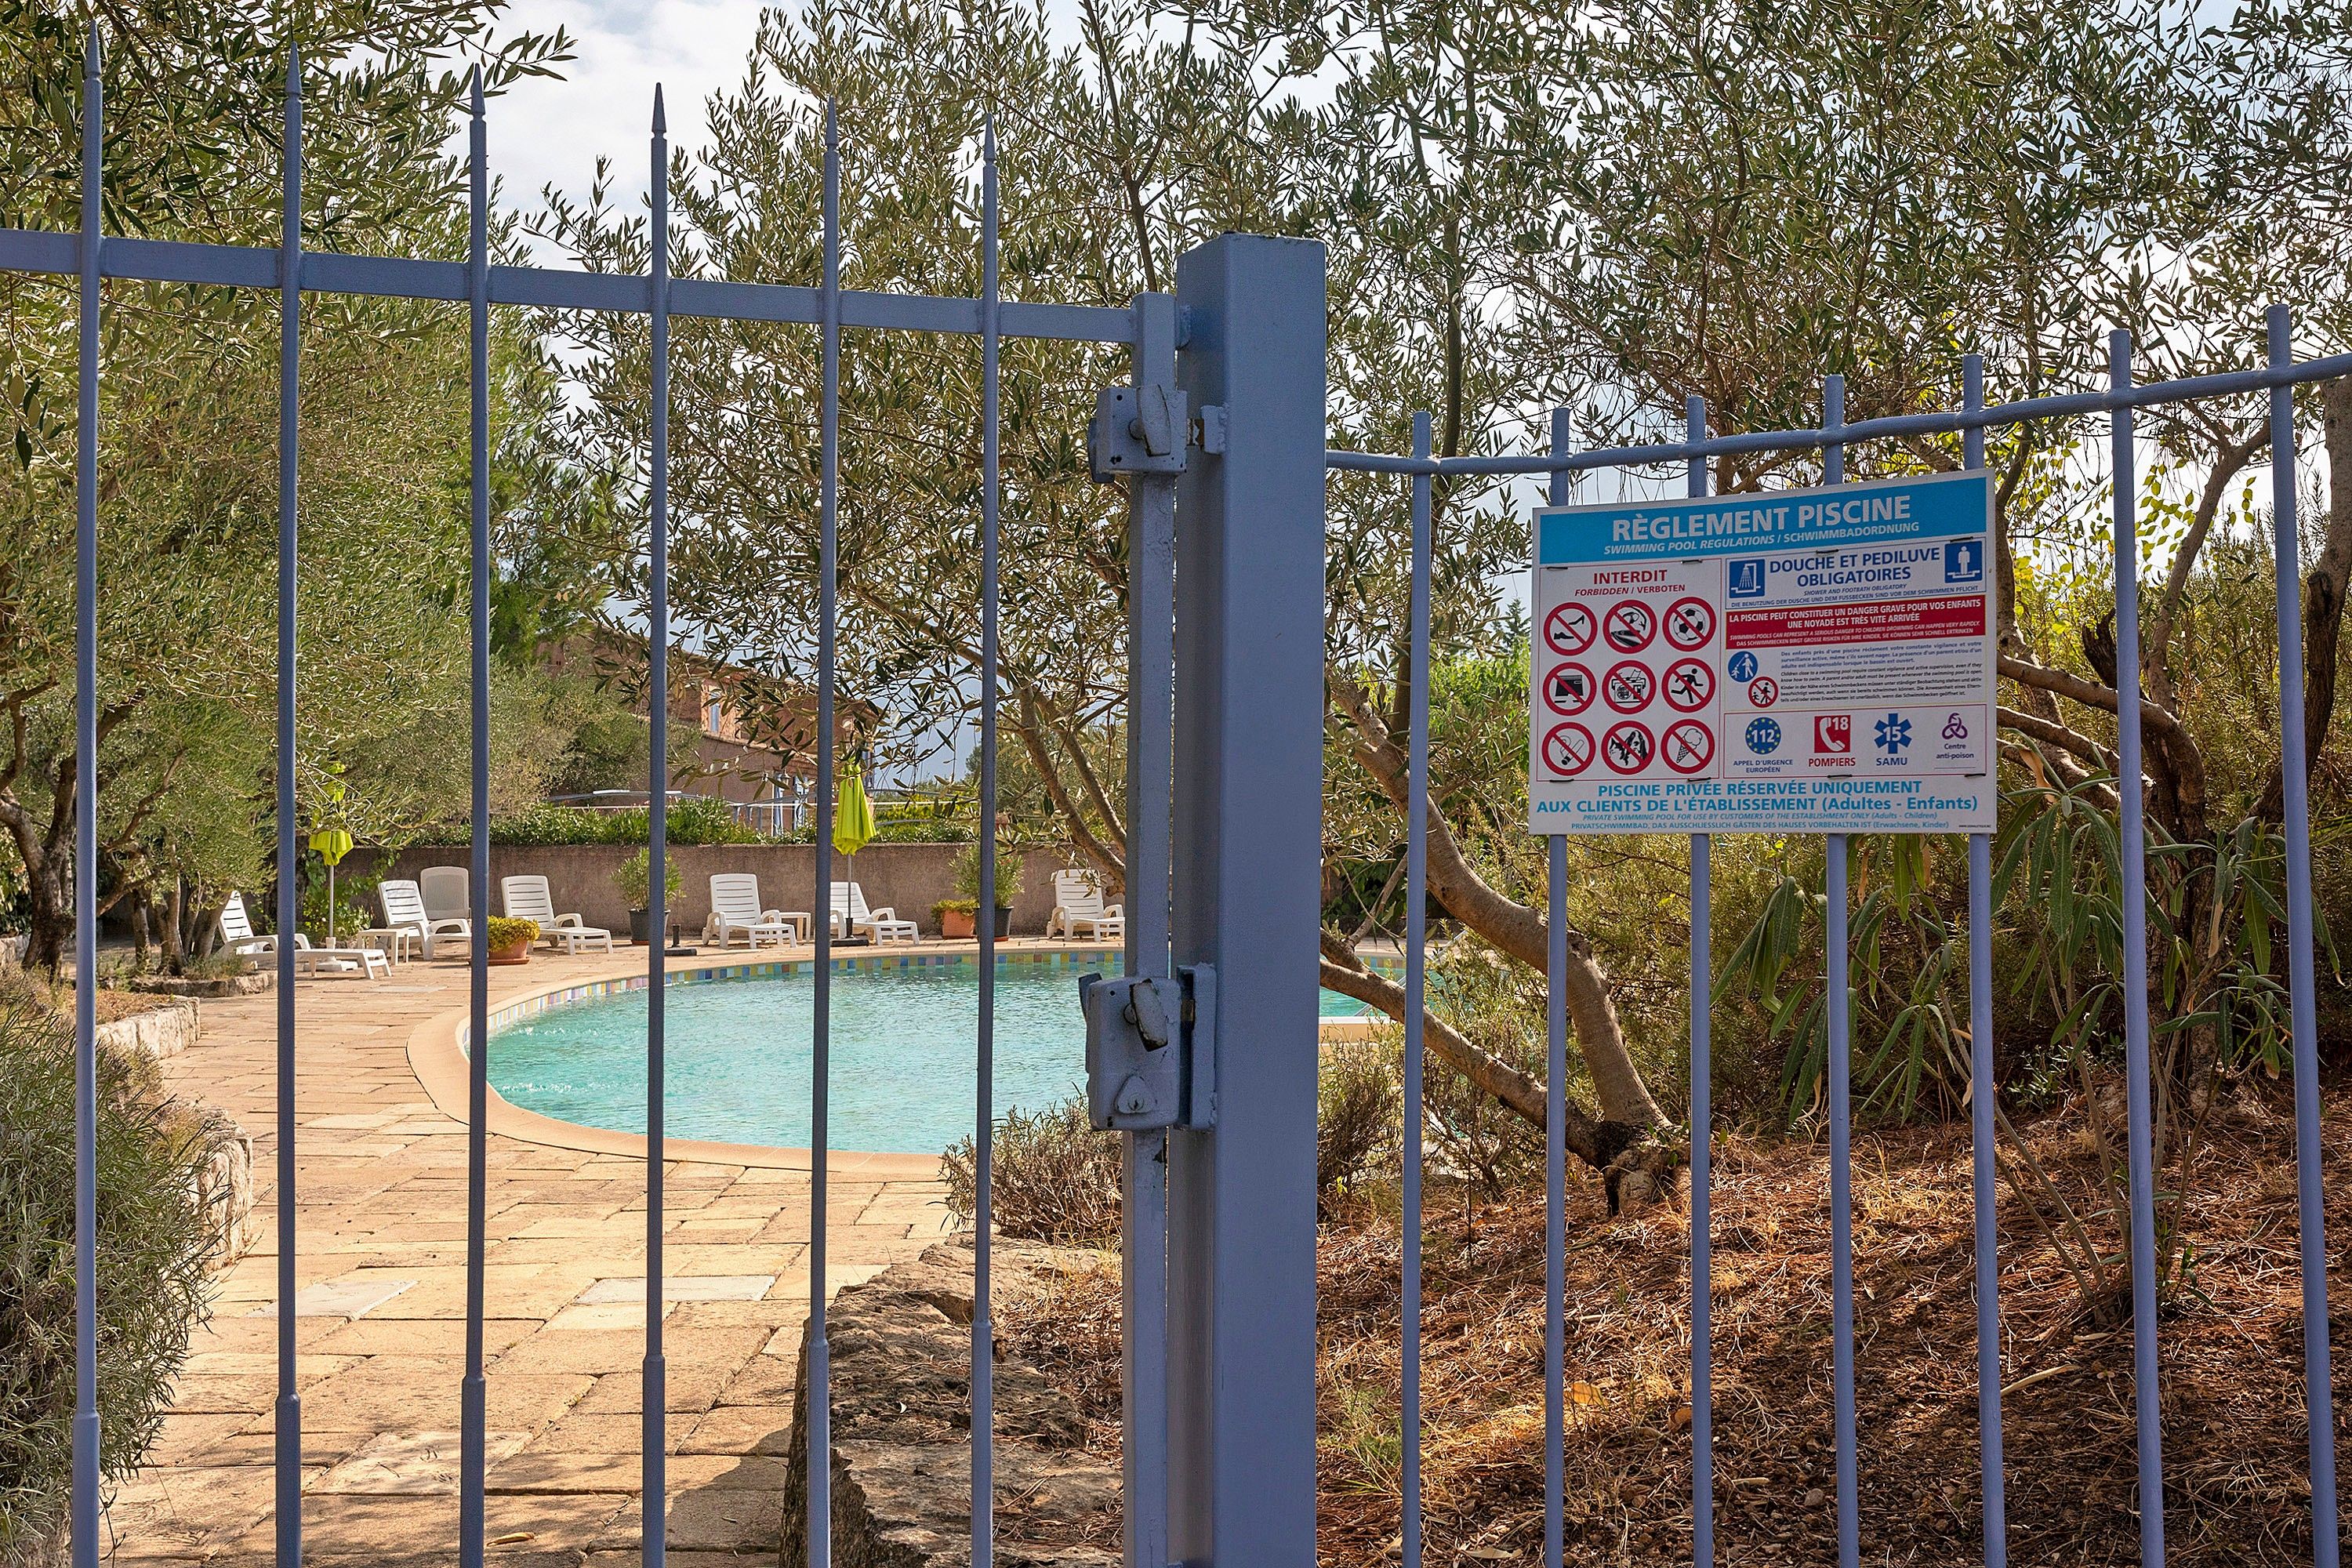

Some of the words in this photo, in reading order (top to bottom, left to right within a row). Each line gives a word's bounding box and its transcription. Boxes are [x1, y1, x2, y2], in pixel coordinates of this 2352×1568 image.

[1613, 506, 1789, 541] RÈGLEMENT
[1798, 495, 1910, 528] PISCINE
[1603, 543, 1664, 554] SWIMMING
[1668, 540, 1697, 550] POOL
[1700, 534, 1774, 548] REGULATIONS
[1784, 521, 1918, 543] SCHWIMMBADORDNUNG
[1769, 556, 1835, 572] DOUCHE
[1840, 554, 1857, 568] ET
[1862, 547, 1940, 565] PEDILUVE
[1594, 569, 1667, 584] INTERDIT
[1797, 566, 1911, 586] OBLIGATOIRES
[1574, 586, 1628, 596] FORBIDDEN
[1636, 584, 1685, 593] VERBOTEN
[1740, 612, 1768, 621] PISCINE
[1789, 608, 1833, 619] CONSTITUER
[1847, 605, 1878, 615] DANGER
[1880, 604, 1905, 612] GRAVE
[1907, 602, 1927, 611] POUR
[1947, 599, 1980, 608] ENFANTS
[1804, 618, 1835, 627] NOYADE
[1850, 615, 1868, 624] TRÈS
[1869, 615, 1886, 623] VITE
[1887, 612, 1919, 622] ARRIVÉE
[1832, 717, 1849, 731] 18
[1751, 729, 1775, 743] 112
[1883, 726, 1901, 742] 15
[1808, 757, 1855, 767] POMPIERS
[1876, 757, 1907, 765] SAMU
[1599, 784, 1660, 797] PISCINE
[1666, 782, 1721, 797] PRIVÉE
[1727, 779, 1806, 794] RÉSERVÉE
[1812, 780, 1922, 796] UNIQUEMENT
[1536, 800, 1570, 812] AUX
[1577, 800, 1641, 811] CLIENTS
[1647, 800, 1668, 811] DE
[1674, 797, 1817, 811] L'ÉTABLISSEMENT
[1822, 797, 1891, 811] (Adultes
[1907, 795, 1976, 811] Enfants)
